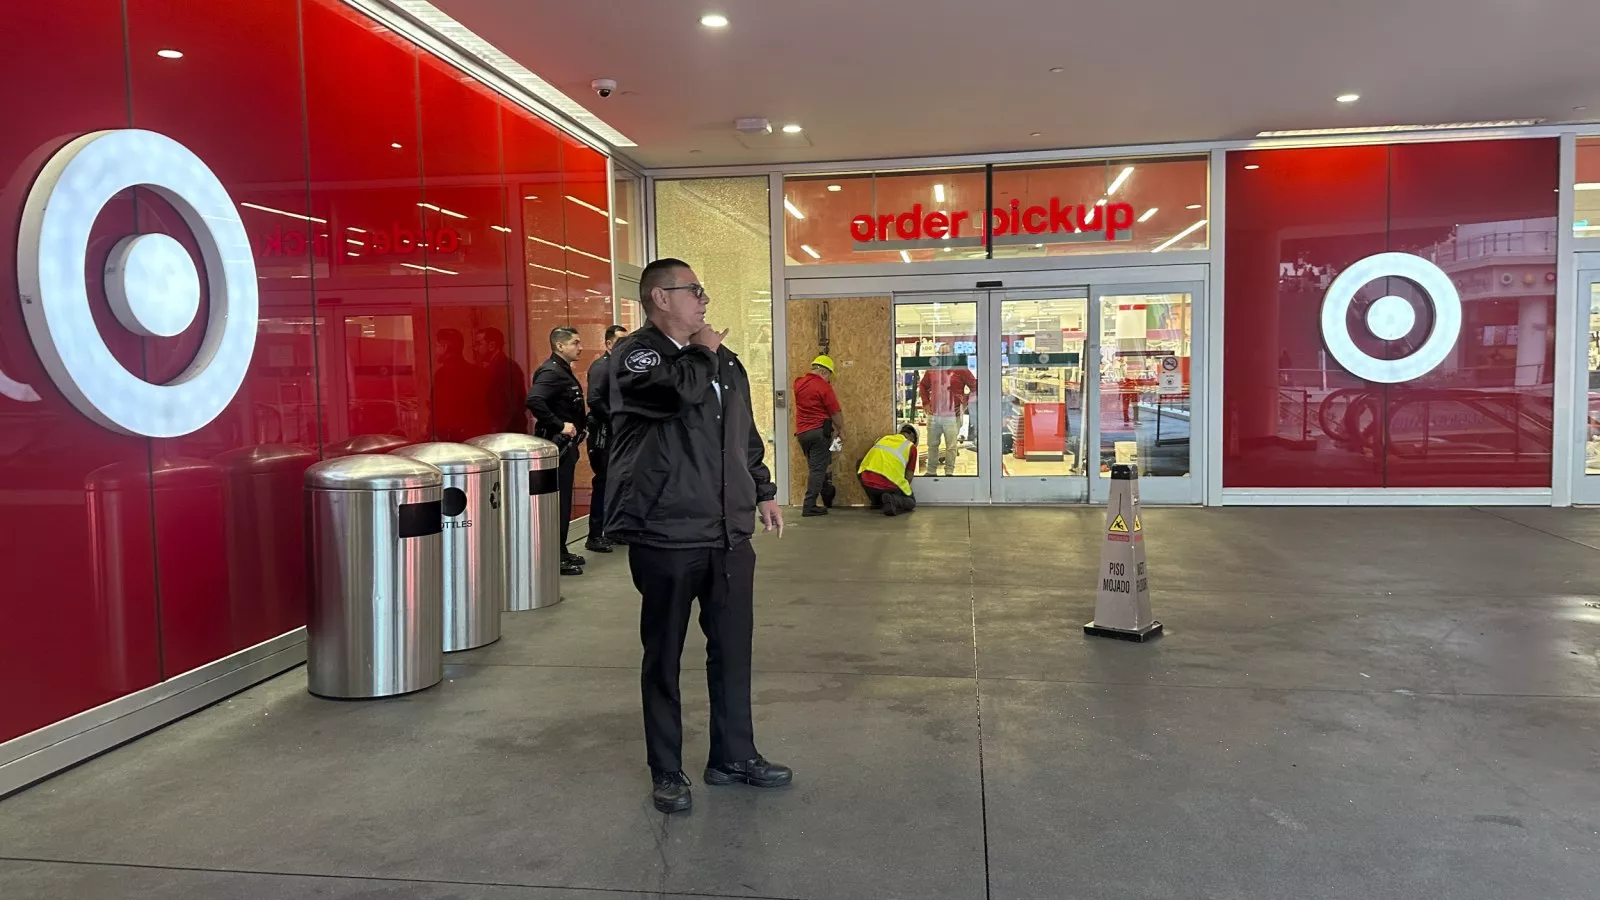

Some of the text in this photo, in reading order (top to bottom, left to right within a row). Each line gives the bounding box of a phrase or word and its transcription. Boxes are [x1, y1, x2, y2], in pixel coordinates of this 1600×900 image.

[850, 197, 1135, 247] order pickup
[441, 520, 472, 529] TTLES
[1109, 562, 1125, 576] PISO
[1103, 578, 1130, 594] MOJADO
